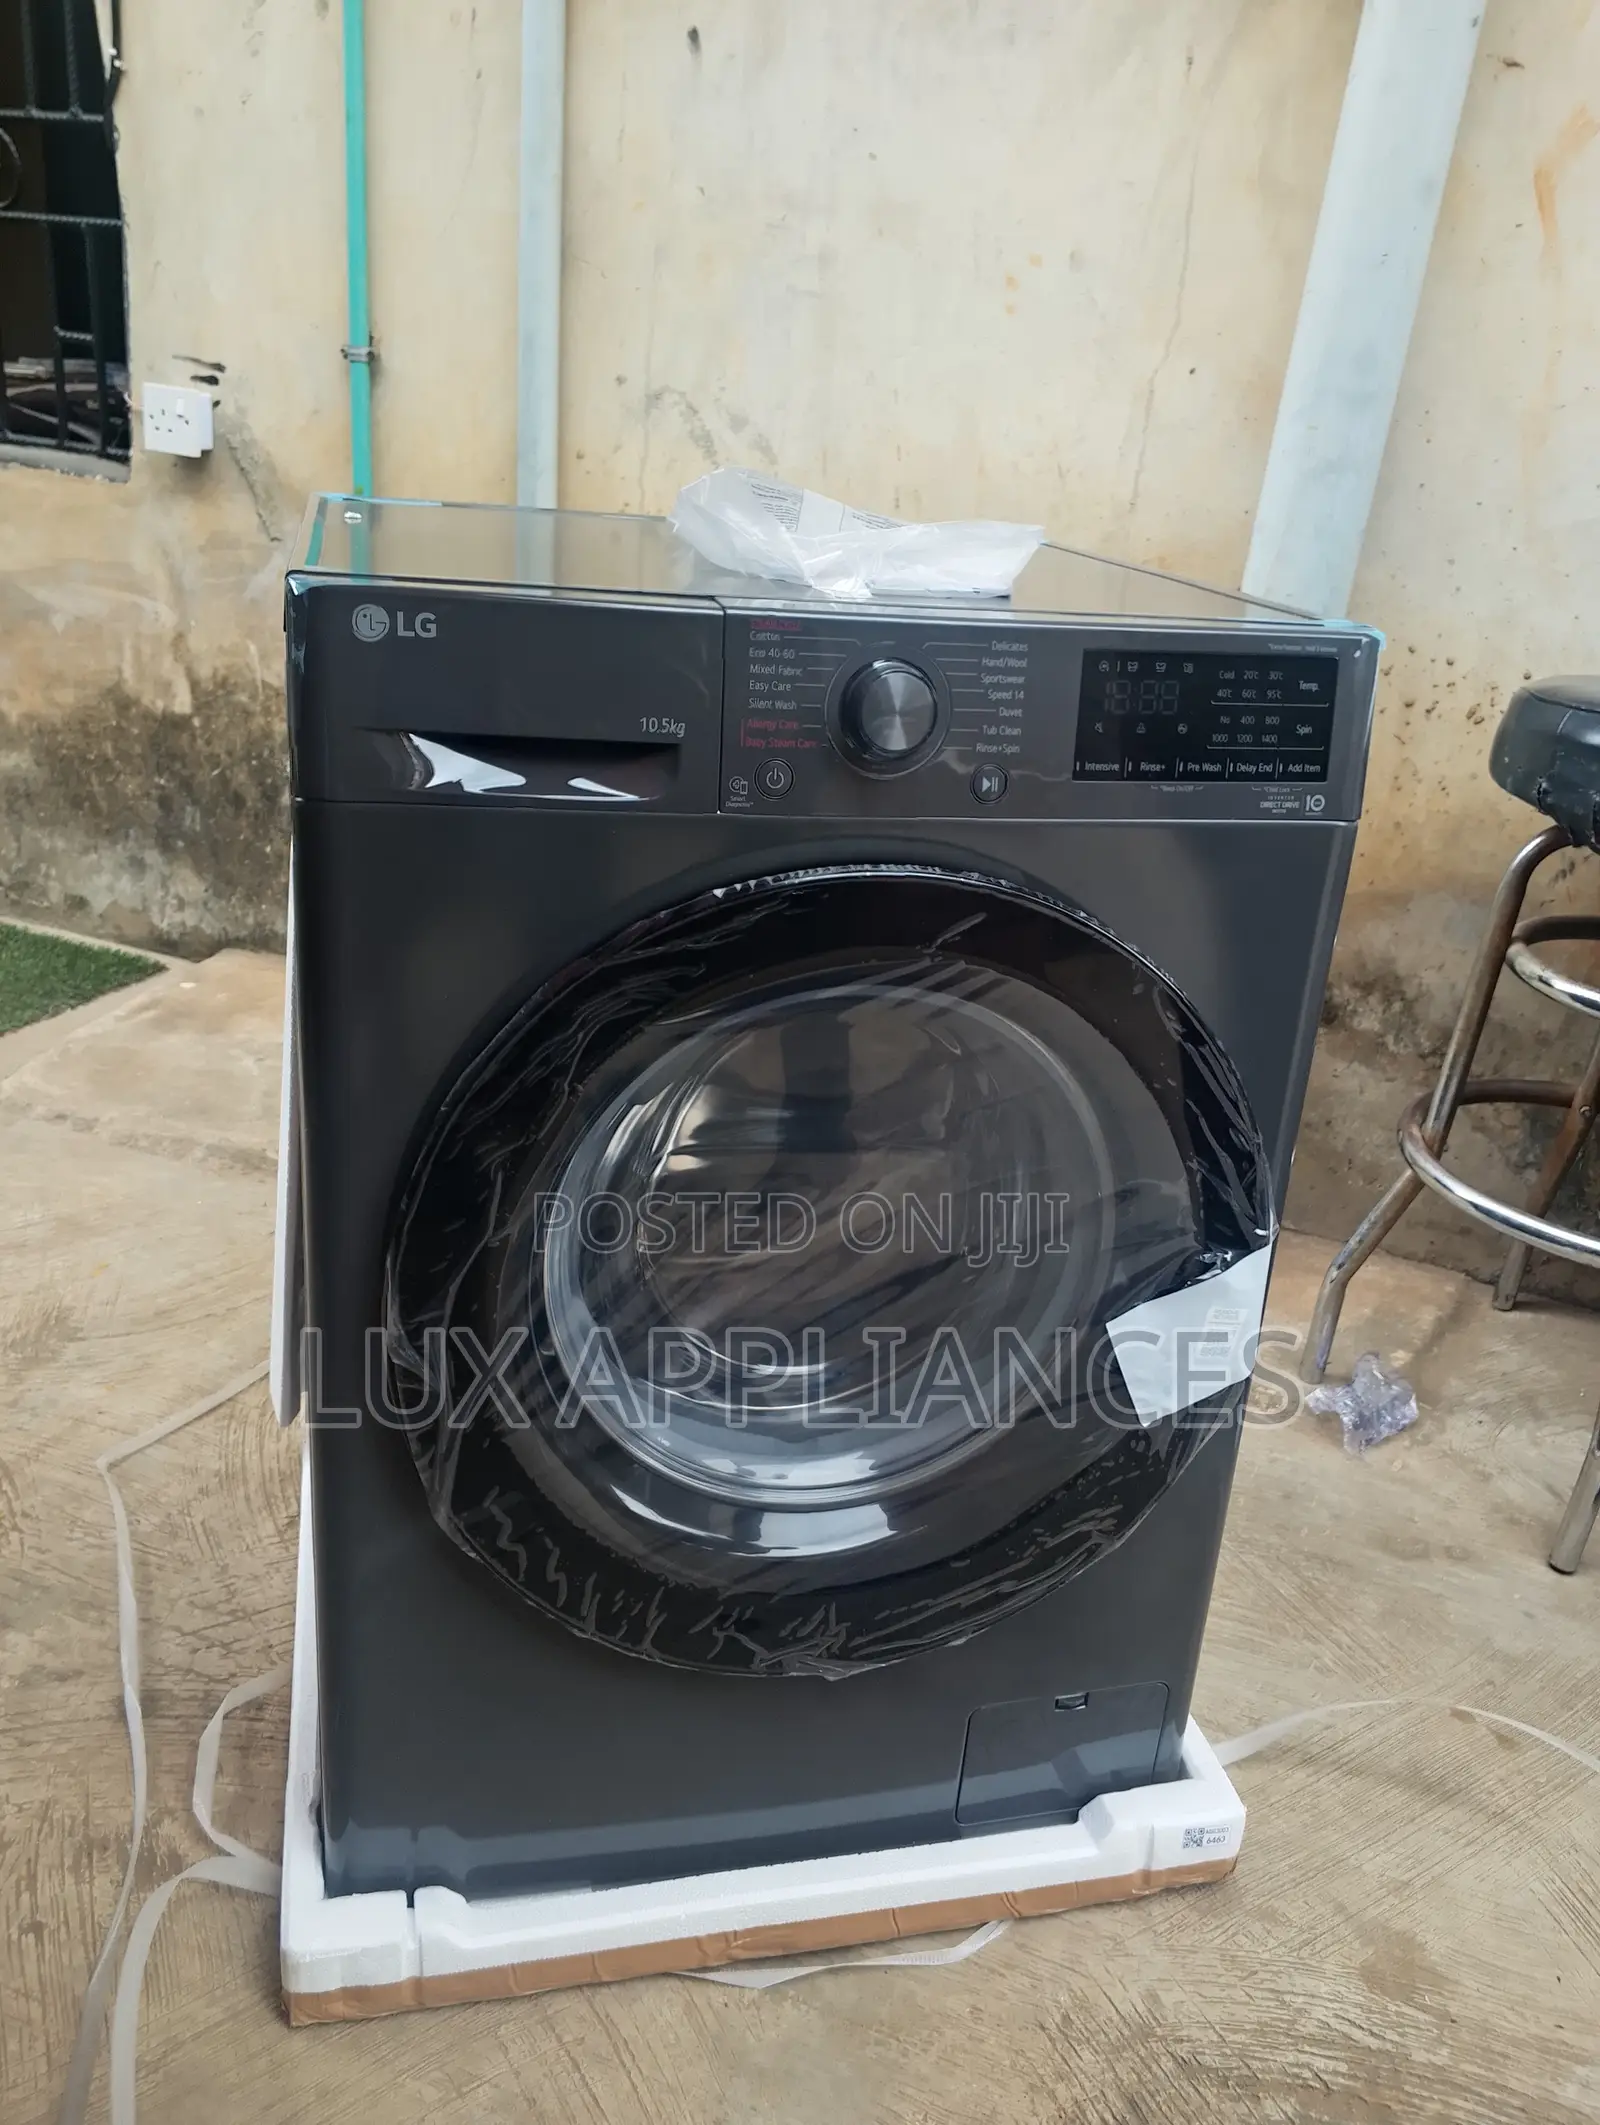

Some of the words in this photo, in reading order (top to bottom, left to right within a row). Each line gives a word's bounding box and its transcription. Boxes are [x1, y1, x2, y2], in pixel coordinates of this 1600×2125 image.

[397, 611, 437, 639] LG
[991, 640, 1029, 652] Delicates
[981, 656, 1028, 668] Hand/Wool
[749, 664, 776, 675] Mixed
[1219, 671, 1236, 680] Cold
[980, 672, 1026, 685] Sportswear
[749, 680, 769, 693] Easy
[771, 681, 792, 692] Care
[987, 689, 1013, 702] Speed
[1015, 690, 1025, 700] 14
[748, 697, 772, 709] Silent
[774, 700, 798, 710] Wash
[1239, 715, 1256, 725] 400
[1264, 716, 1280, 725] 800
[639, 716, 686, 738] 10.5kg
[982, 724, 998, 736] Tub
[999, 725, 1022, 737] Clean
[1295, 724, 1313, 736] Spin
[1236, 734, 1253, 743] 1200
[1261, 734, 1278, 743] 1400
[1085, 761, 1120, 772] Intensive
[1140, 761, 1166, 772] Rinse+
[1187, 762, 1200, 772] Pre
[1201, 762, 1222, 773] Wash
[1236, 763, 1257, 774] Delay
[1258, 763, 1273, 772] End
[1287, 763, 1303, 772] Add
[1304, 763, 1321, 773] Item
